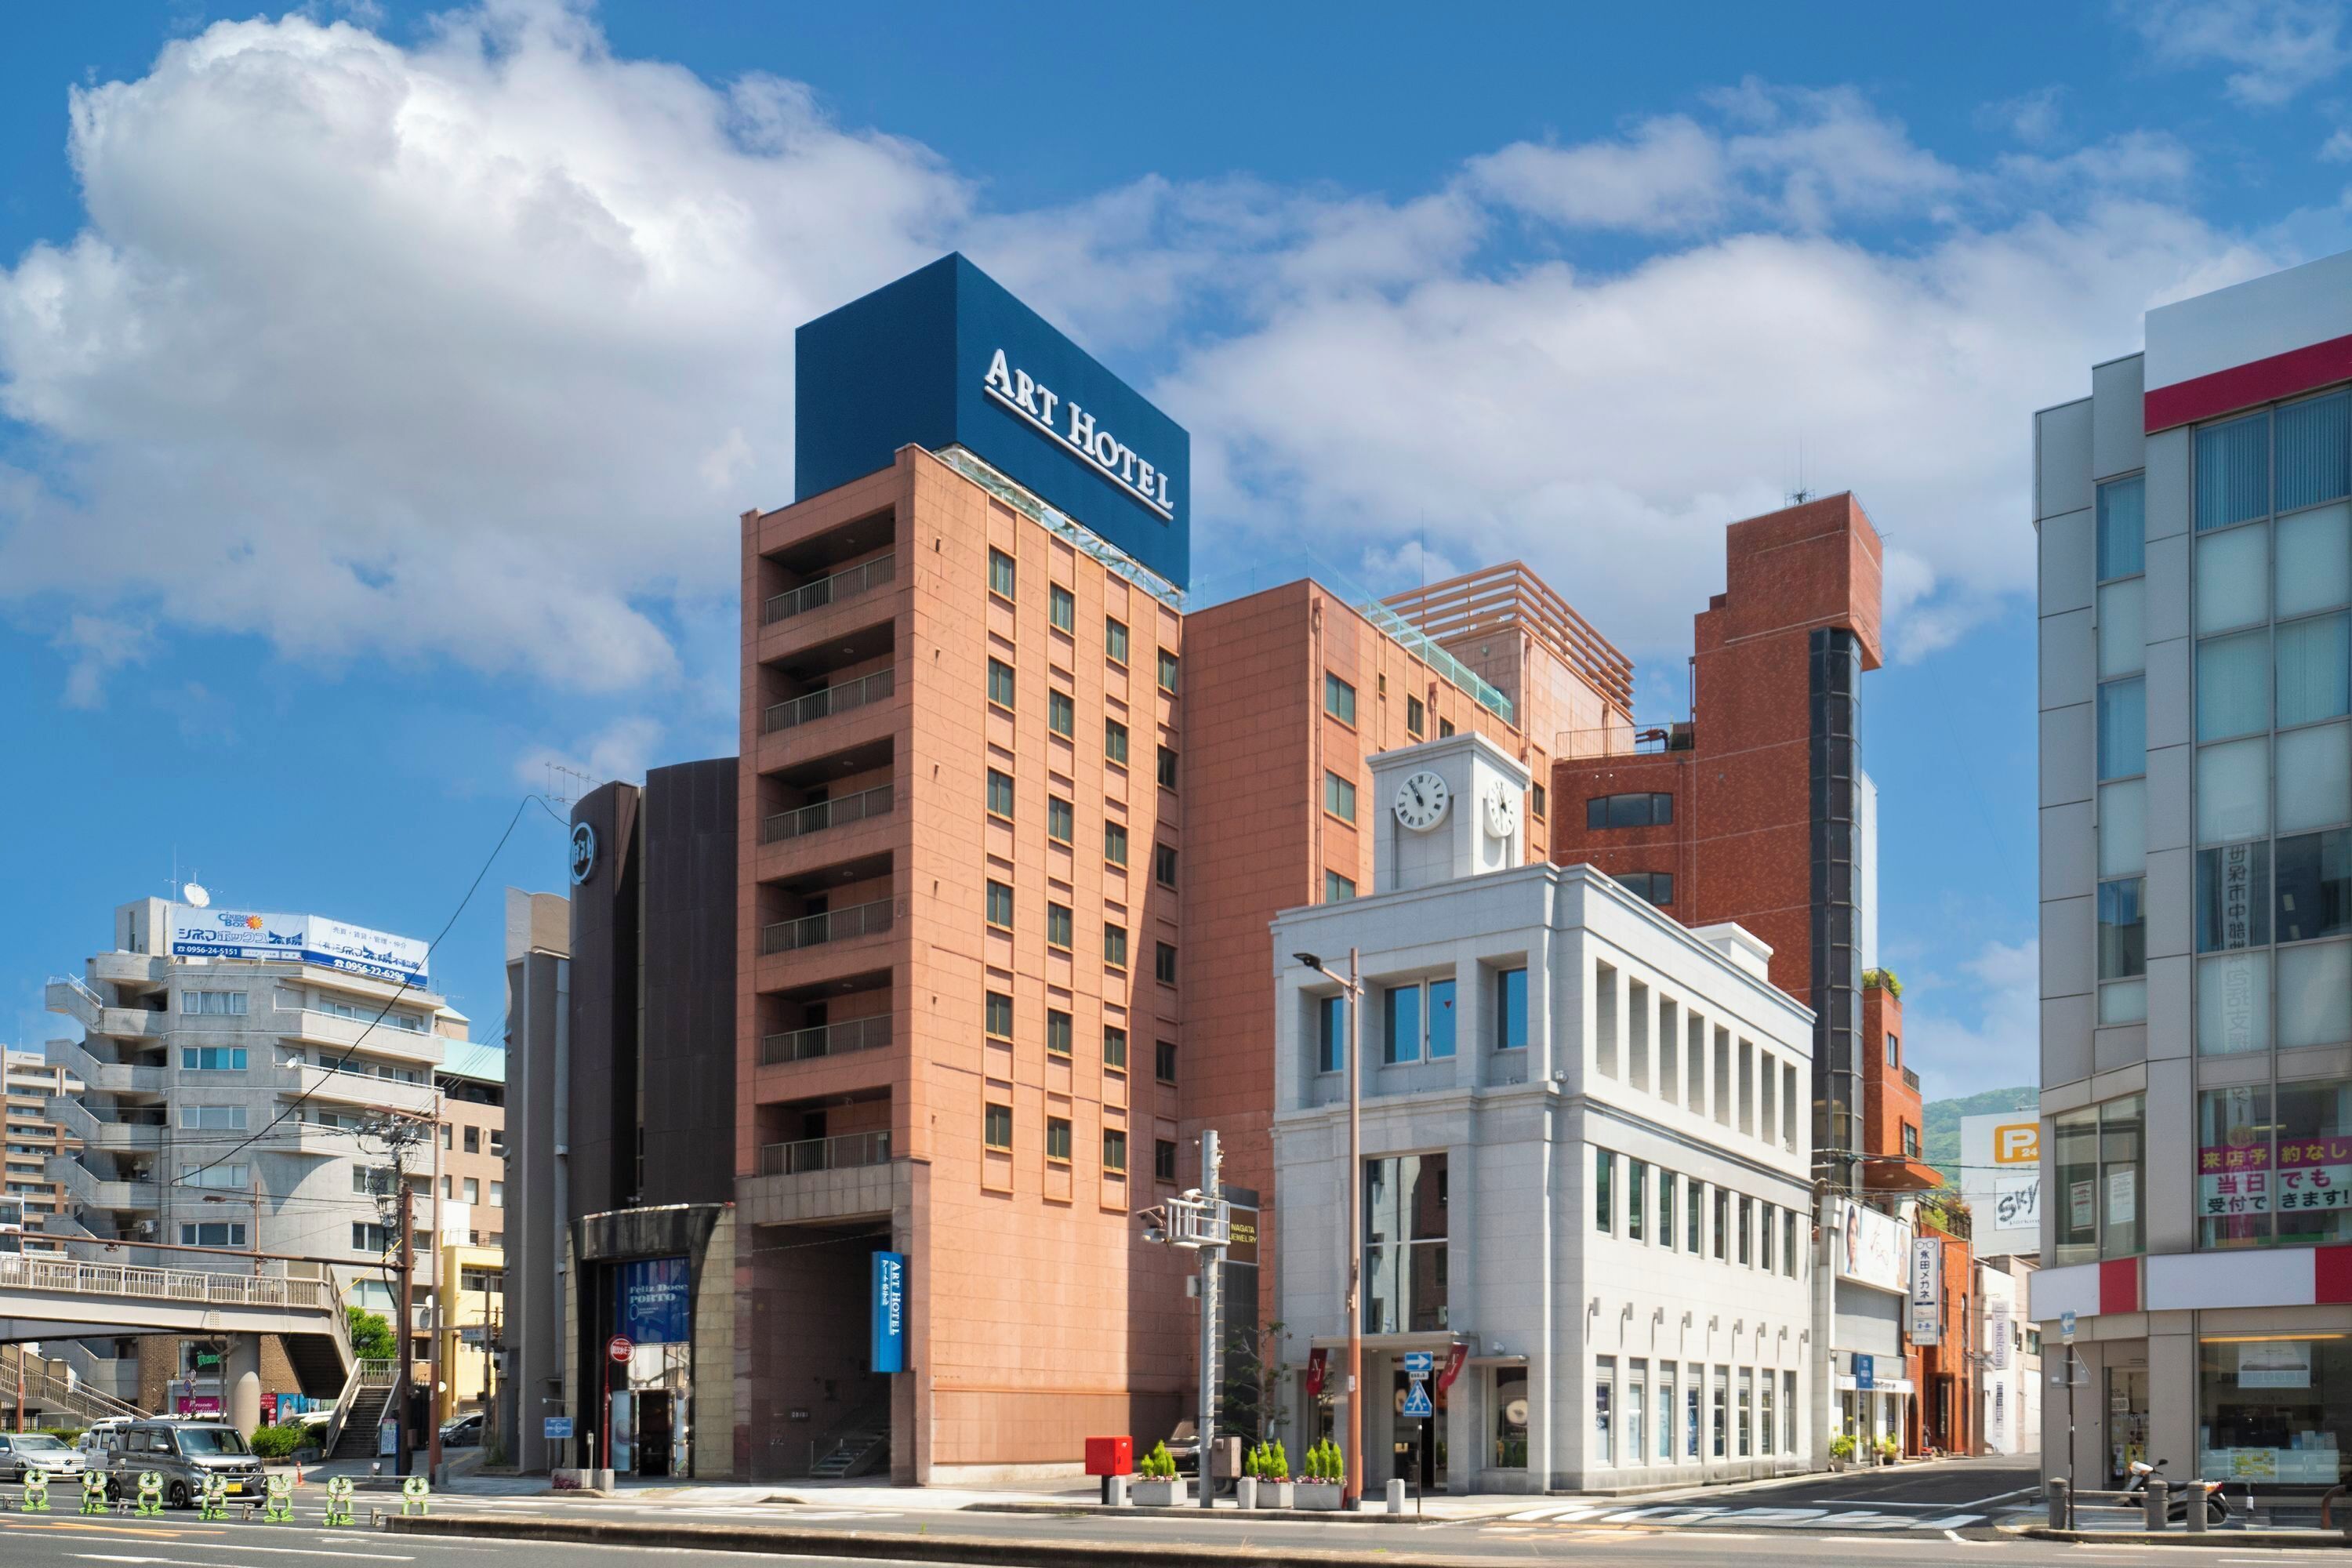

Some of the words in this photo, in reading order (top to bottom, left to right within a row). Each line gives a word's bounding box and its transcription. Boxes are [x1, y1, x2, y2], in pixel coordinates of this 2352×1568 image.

[984, 348, 1058, 426] ART
[1068, 401, 1174, 510] HOTEL
[187, 946, 238, 955] 0956-24-5151
[2003, 1129, 2037, 1159] P
[2022, 1147, 2038, 1157] 24
[2202, 1142, 2347, 1168] 来店予約なし
[2217, 1169, 2331, 1194] 当日でも
[1229, 1233, 1257, 1243] JEWELRY
[1231, 1224, 1254, 1234] NAGATA
[892, 1261, 902, 1288] ART
[891, 1292, 902, 1336] HOTEL
